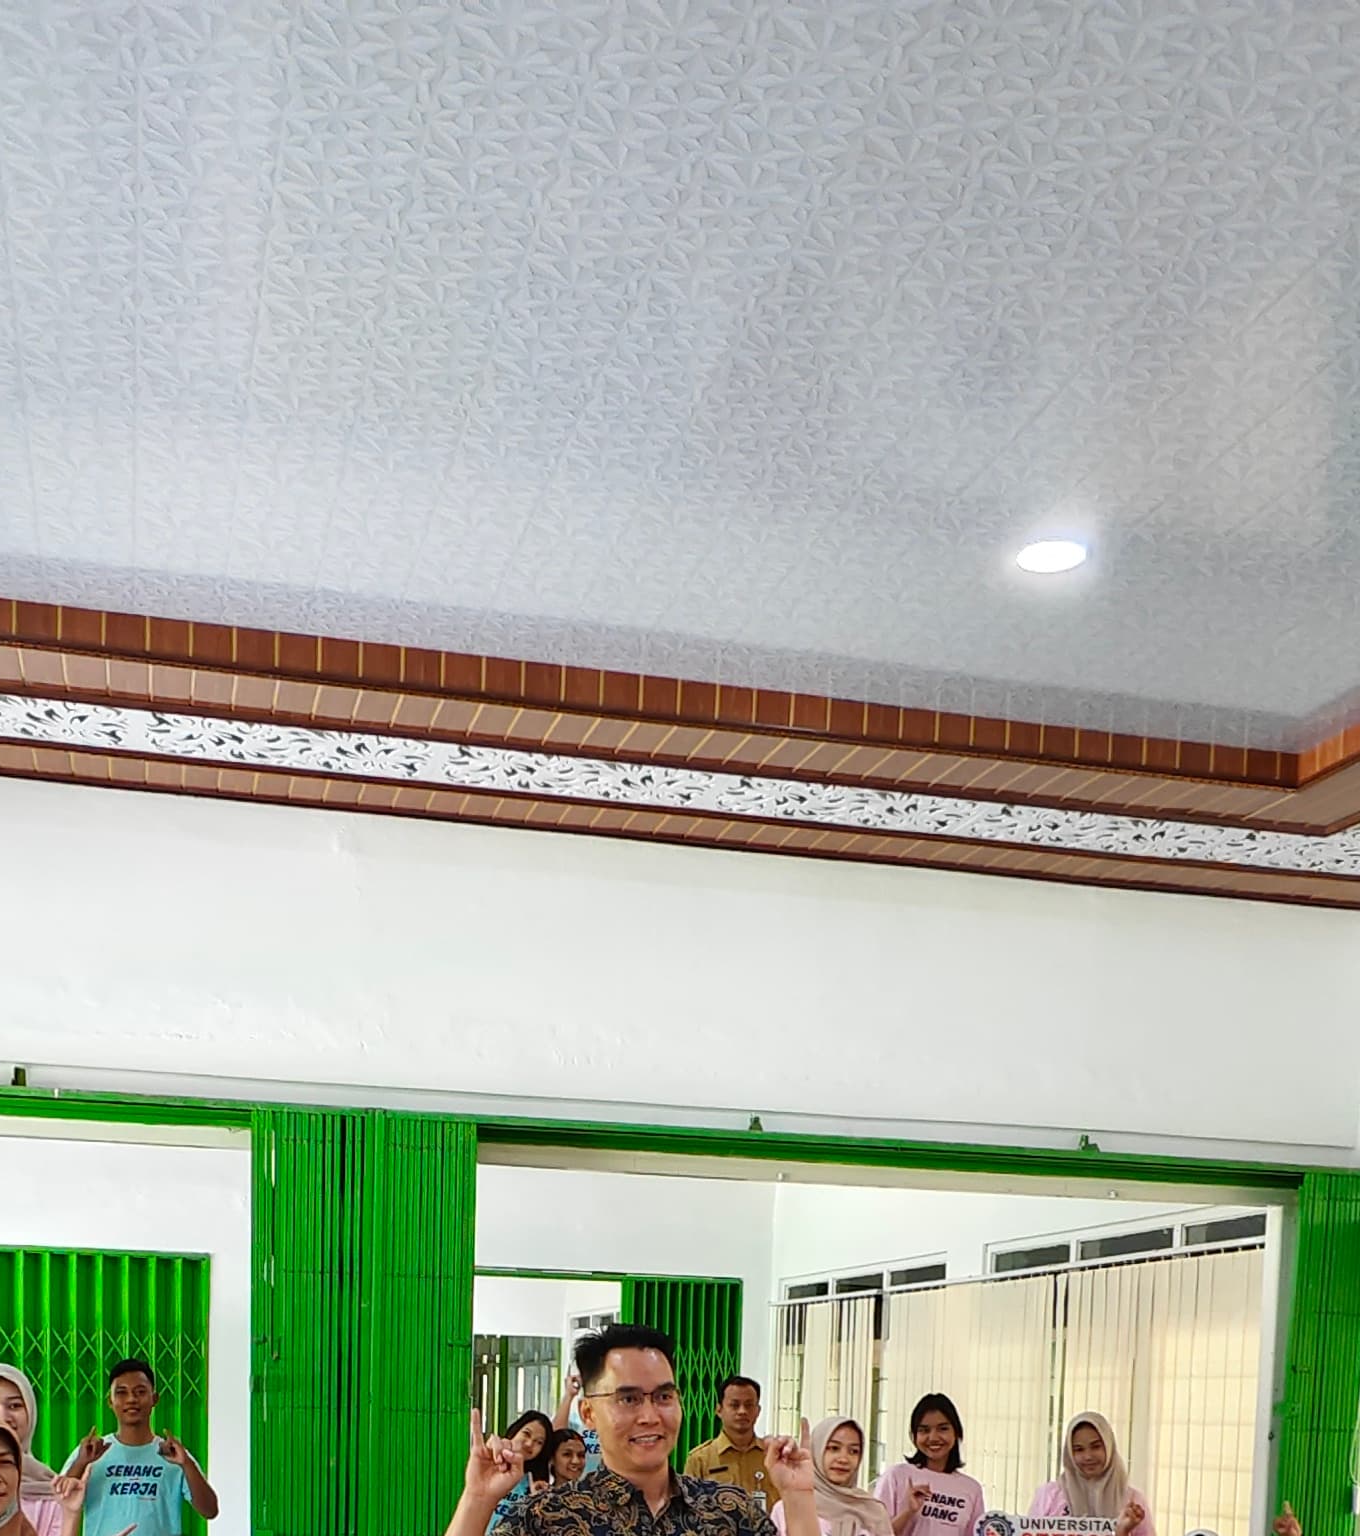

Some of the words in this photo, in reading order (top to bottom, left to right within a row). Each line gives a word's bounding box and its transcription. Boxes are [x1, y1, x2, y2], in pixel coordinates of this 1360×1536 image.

[105, 1464, 164, 1478] SENANG
[109, 1482, 158, 1497] KERJA
[921, 1505, 959, 1522] UANG
